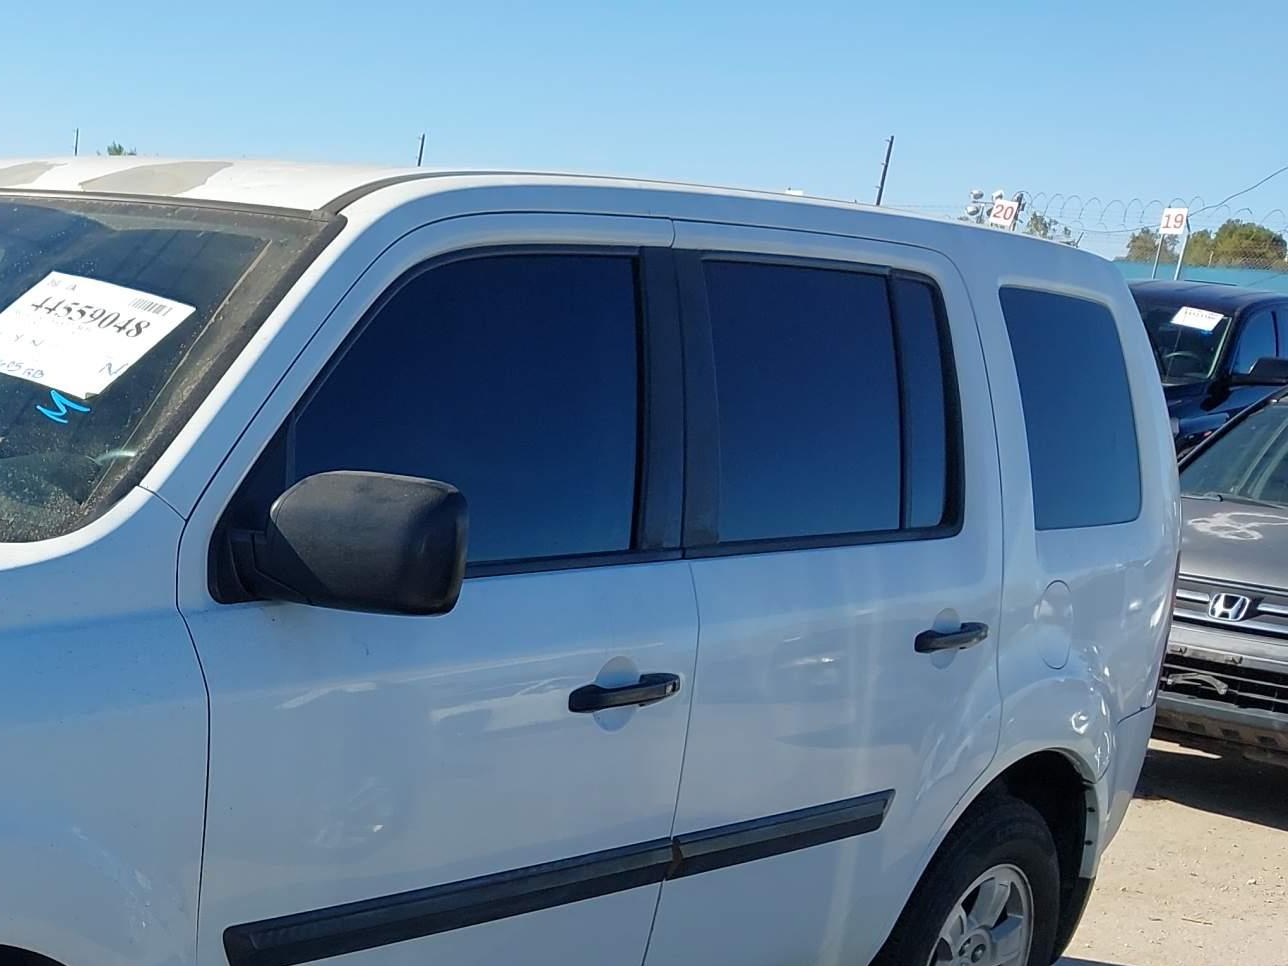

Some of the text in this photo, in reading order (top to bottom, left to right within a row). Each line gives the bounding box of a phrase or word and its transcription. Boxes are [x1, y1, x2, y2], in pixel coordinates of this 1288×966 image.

[992, 204, 1014, 220] 20
[1162, 213, 1185, 229] 19
[31, 296, 150, 338] 44559048
